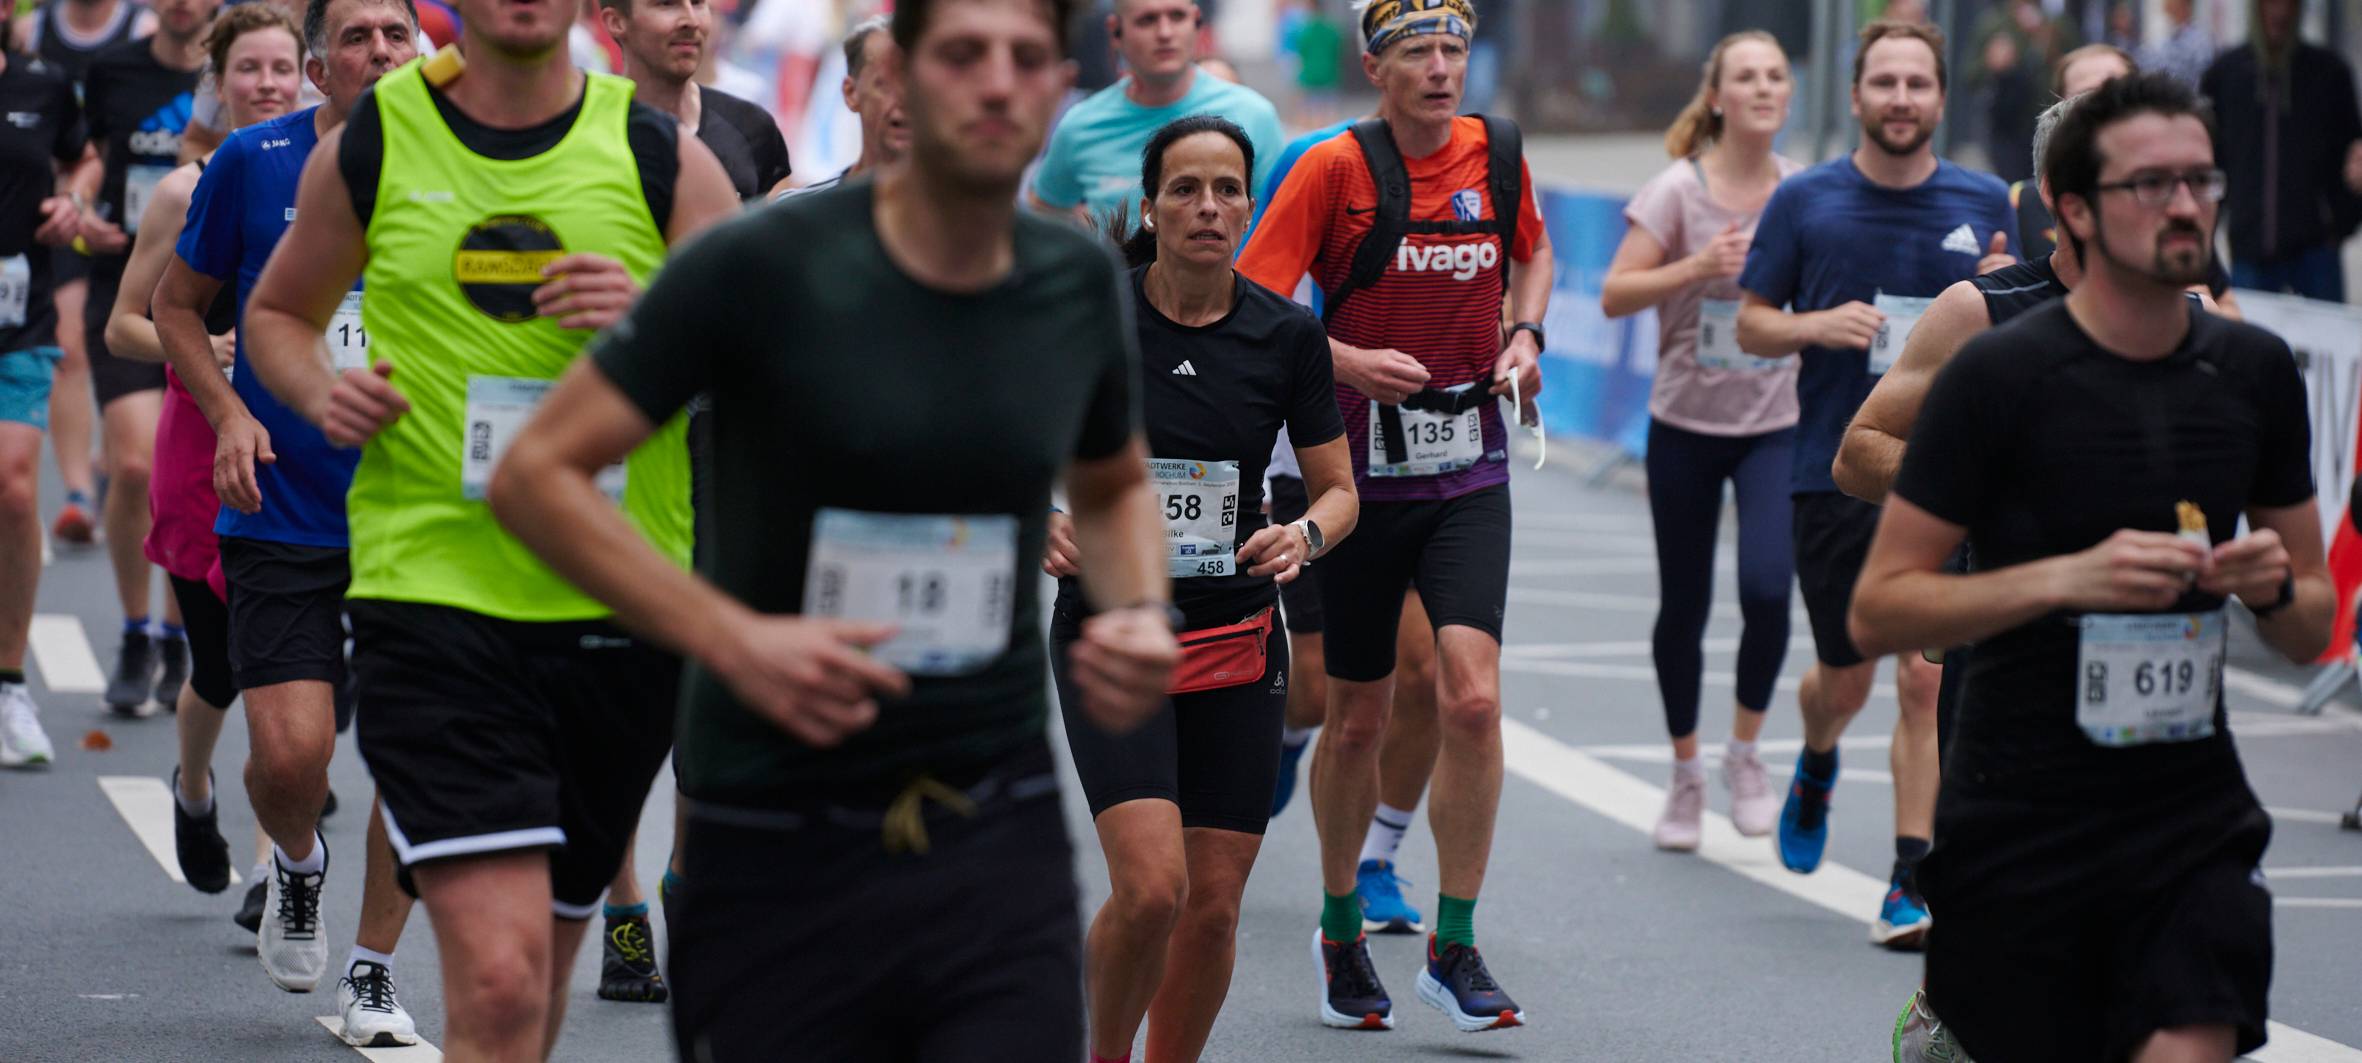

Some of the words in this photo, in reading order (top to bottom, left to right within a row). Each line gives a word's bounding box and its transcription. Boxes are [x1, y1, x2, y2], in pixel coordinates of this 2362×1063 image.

[1397, 236, 1497, 281] ivago
[1408, 420, 1454, 445] 135
[1416, 450, 1448, 460] Gerhard
[1158, 494, 1202, 520] 58
[1197, 560, 1225, 575] 458
[2134, 658, 2194, 697] 619
